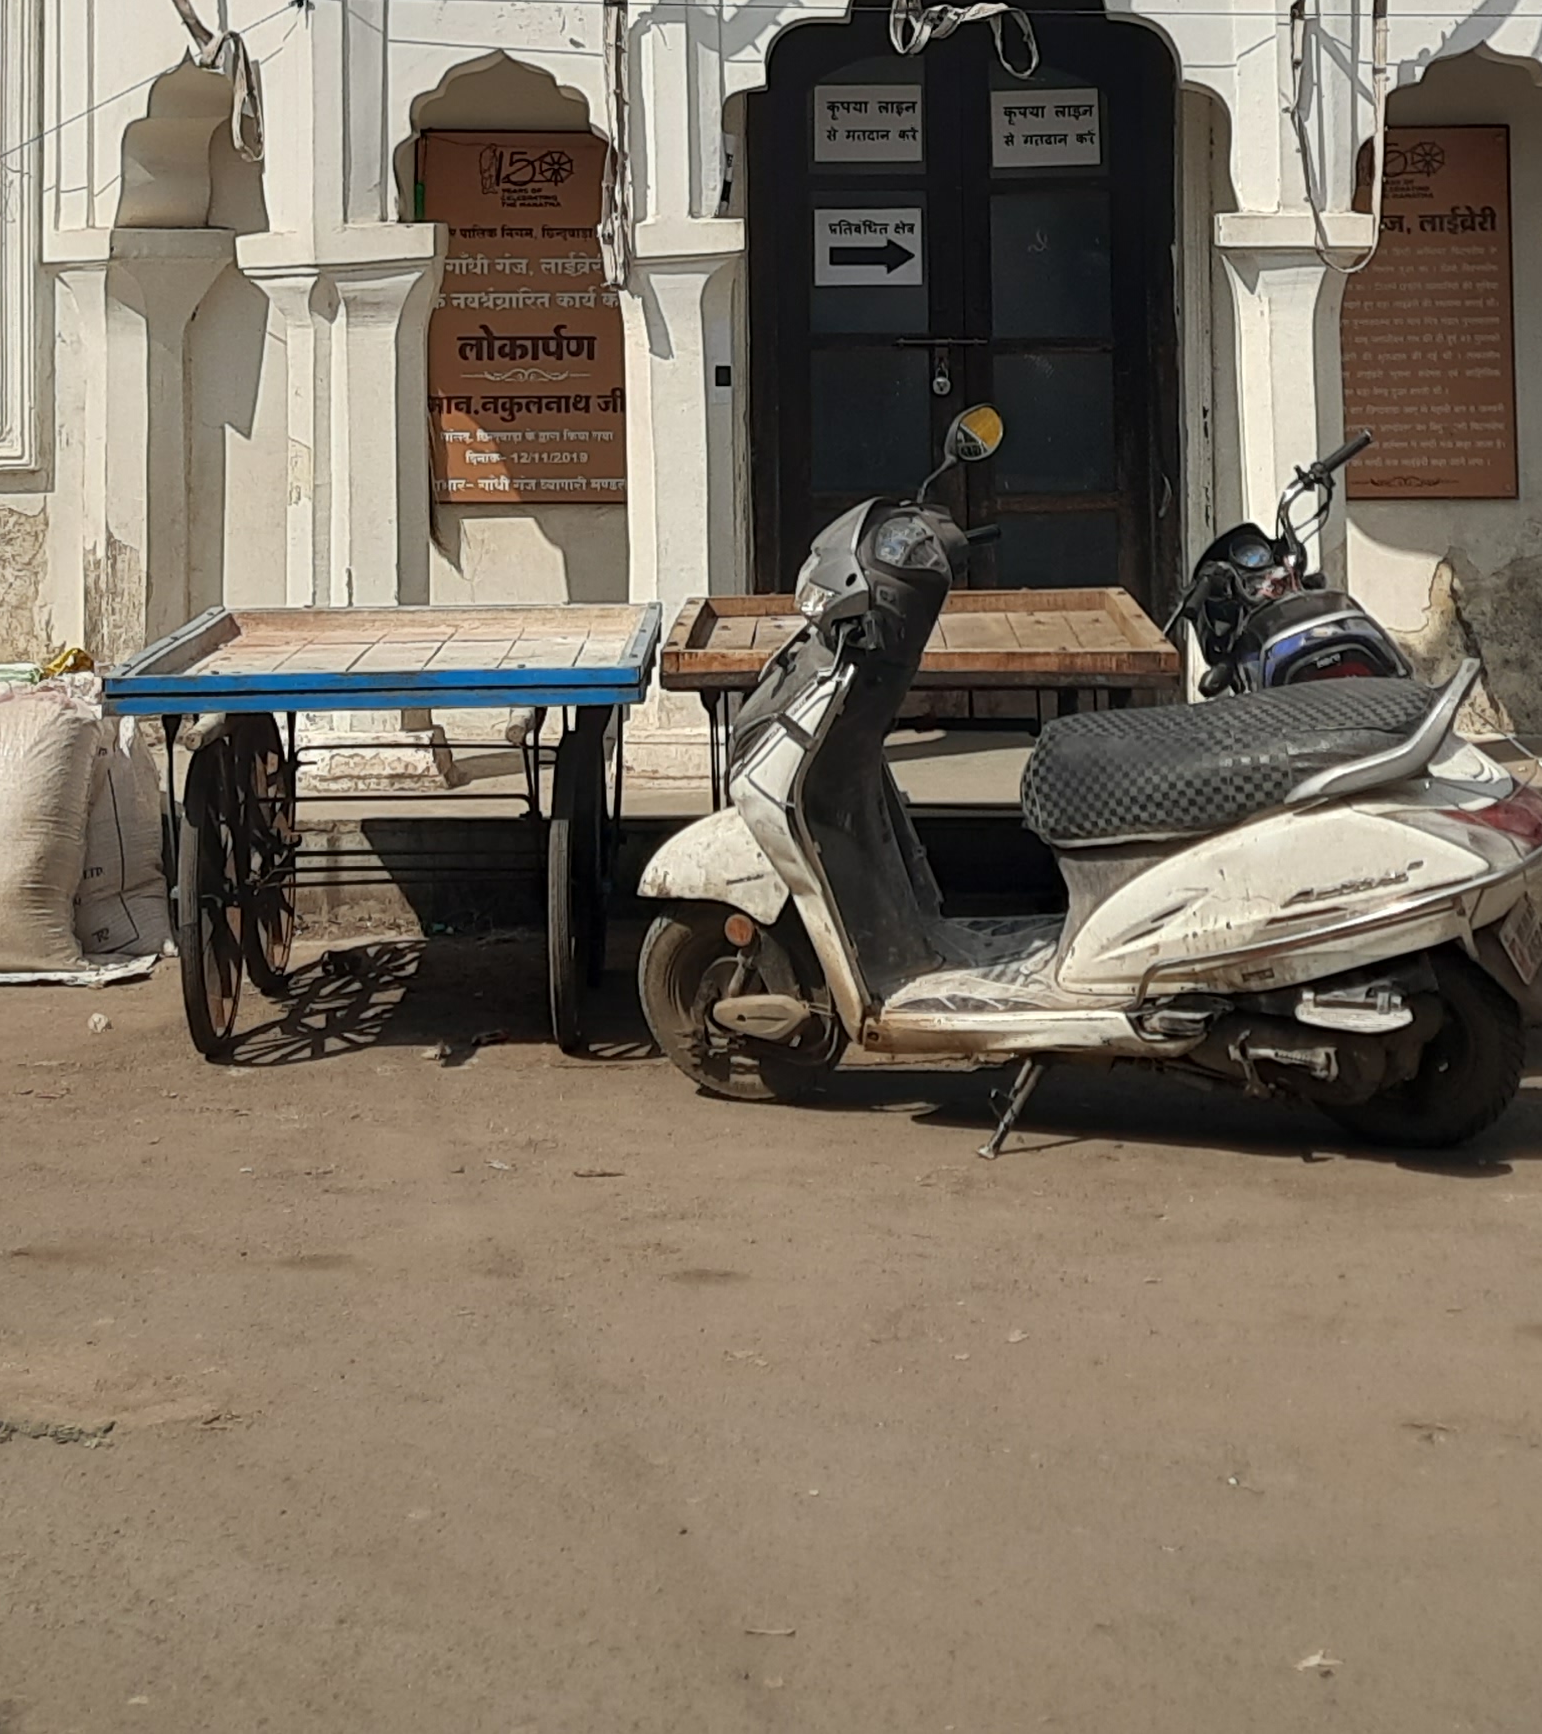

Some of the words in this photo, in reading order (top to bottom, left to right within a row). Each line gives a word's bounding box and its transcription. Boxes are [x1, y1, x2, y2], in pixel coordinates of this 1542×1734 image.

[877, 100, 918, 117] लाइन
[1054, 104, 1094, 121] लाइन
[845, 128, 891, 142] मतदान
[457, 324, 597, 362] लोकार्पण
